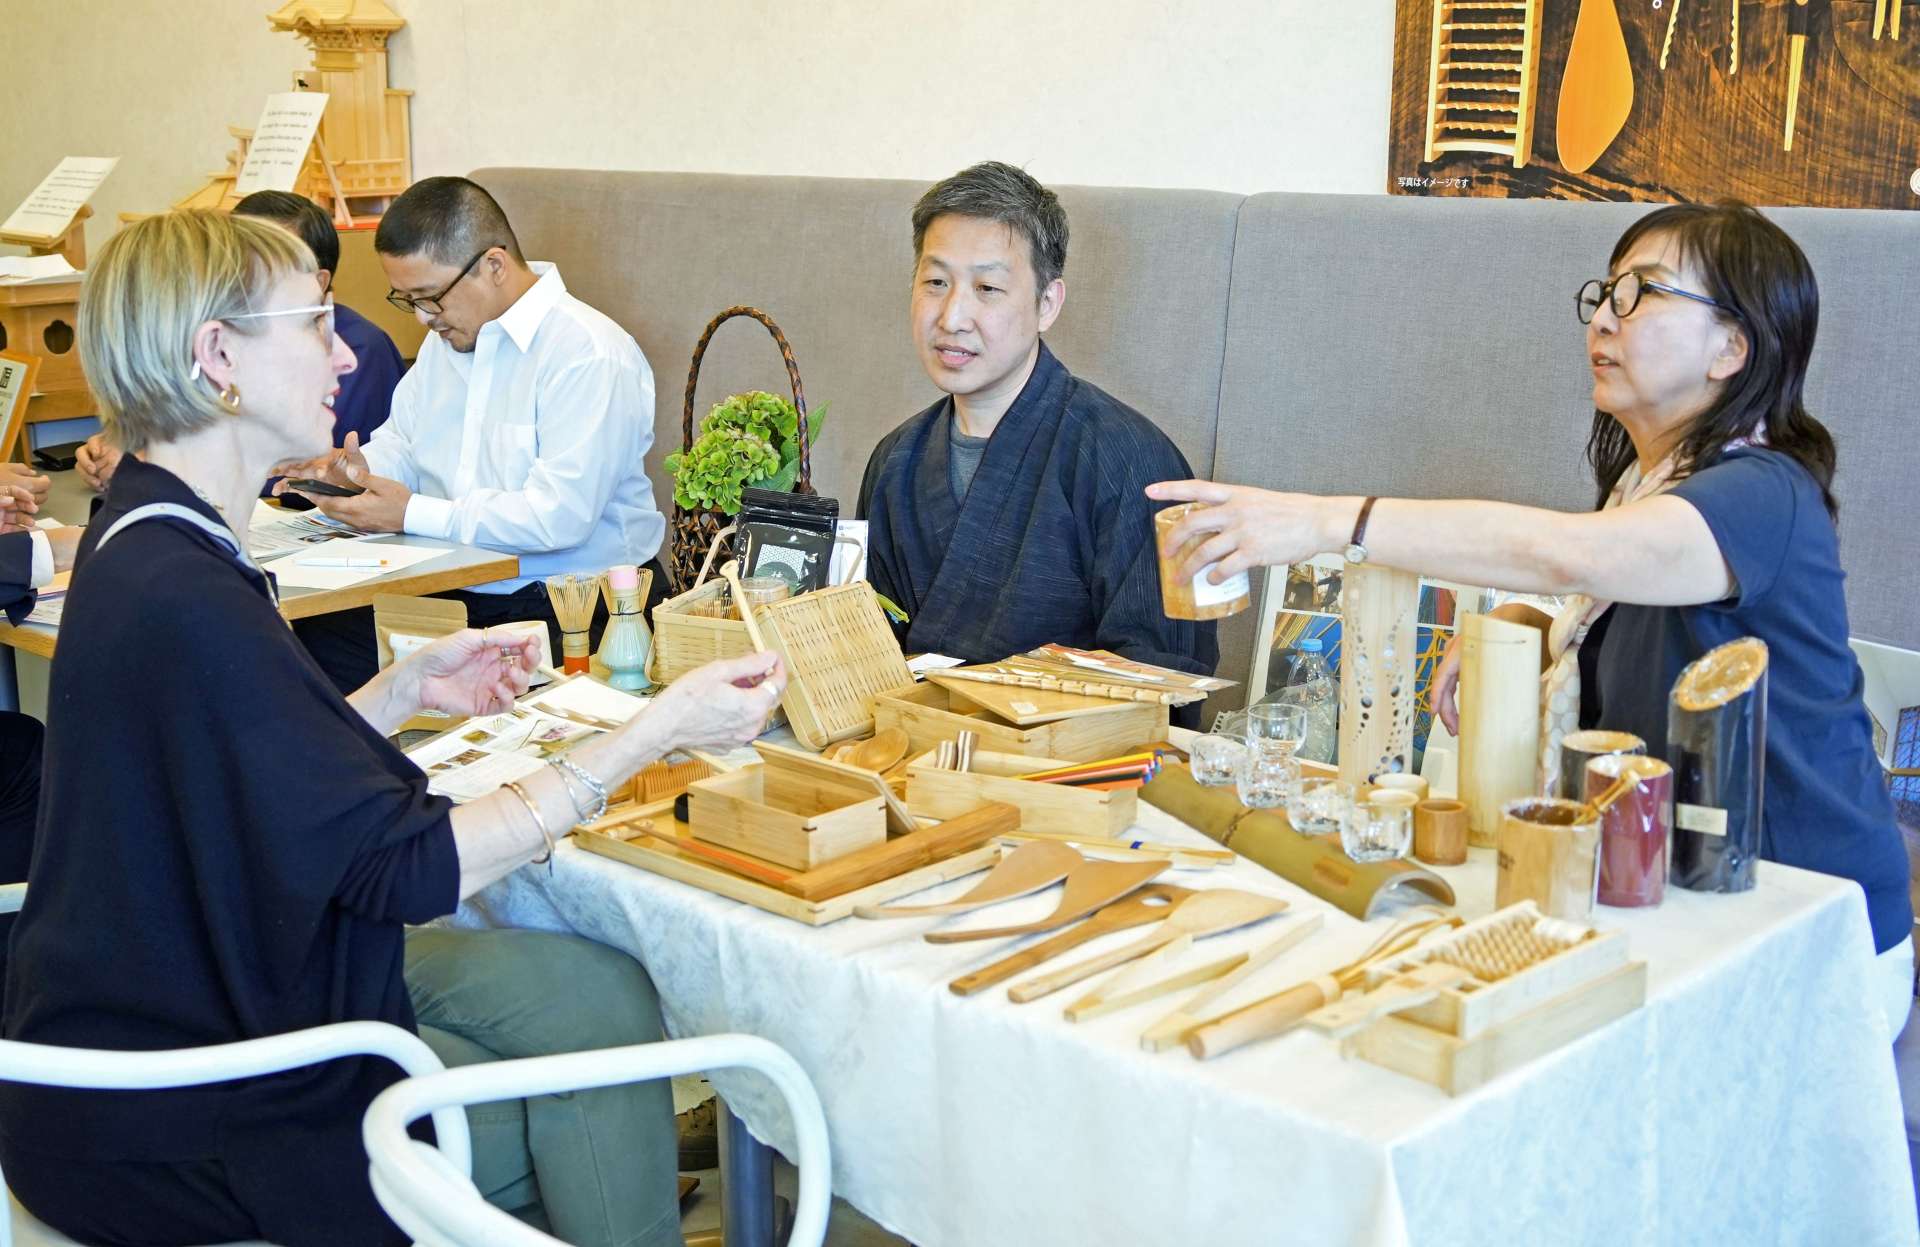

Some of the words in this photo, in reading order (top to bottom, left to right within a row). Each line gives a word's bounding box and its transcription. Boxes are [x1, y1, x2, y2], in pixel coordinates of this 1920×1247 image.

[1397, 176, 1469, 189] 写真はイメージです
